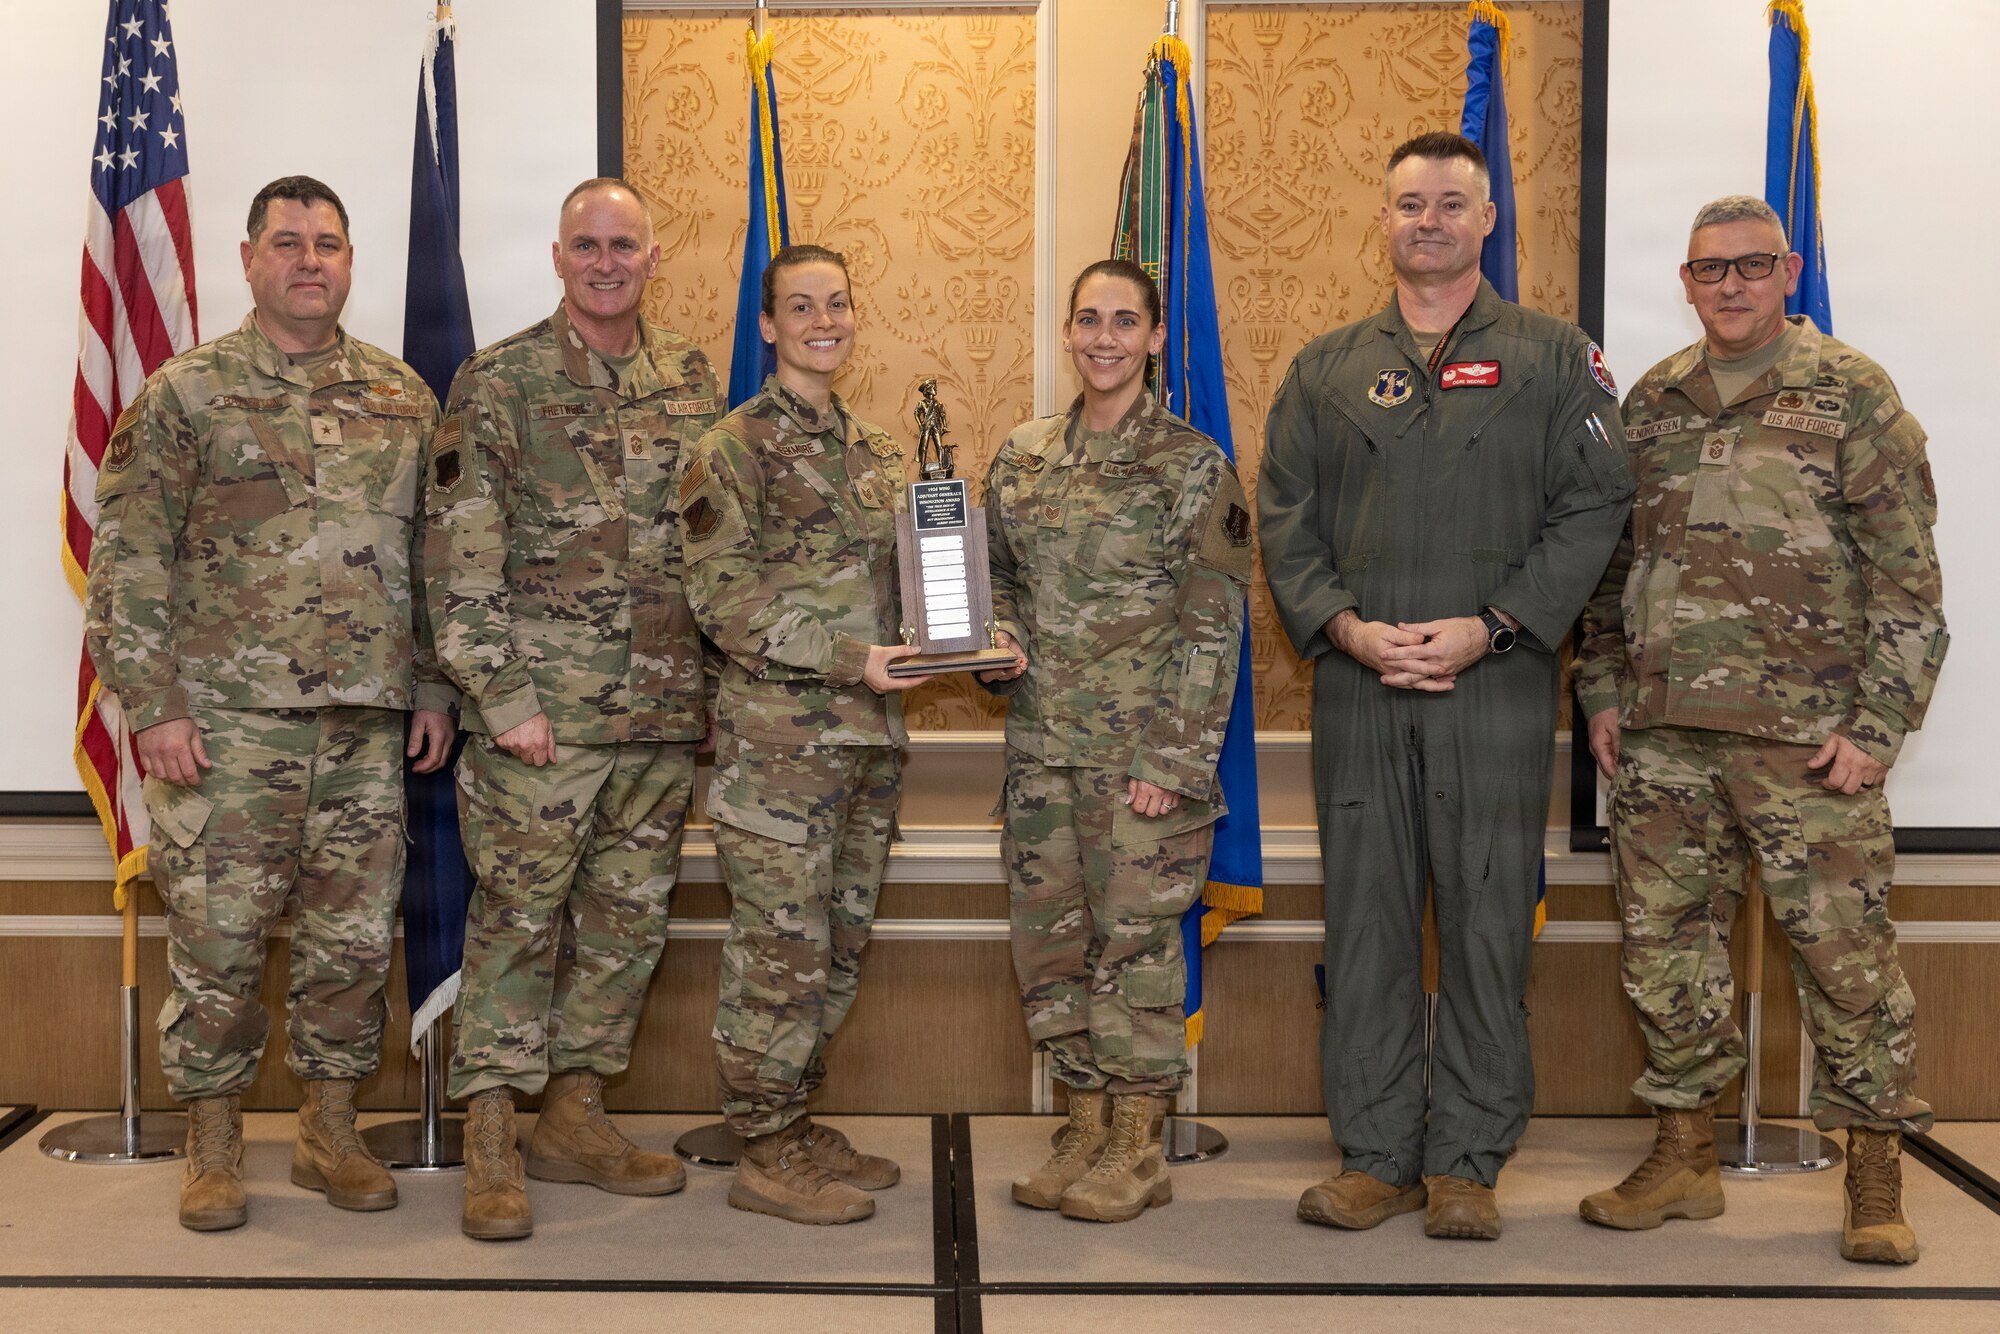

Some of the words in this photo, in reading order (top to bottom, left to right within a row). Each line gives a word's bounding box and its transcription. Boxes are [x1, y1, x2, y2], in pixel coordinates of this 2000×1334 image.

[688, 400, 714, 414] FORCE
[1785, 415, 1805, 430] AIR
[1805, 419, 1842, 437] FORCE
